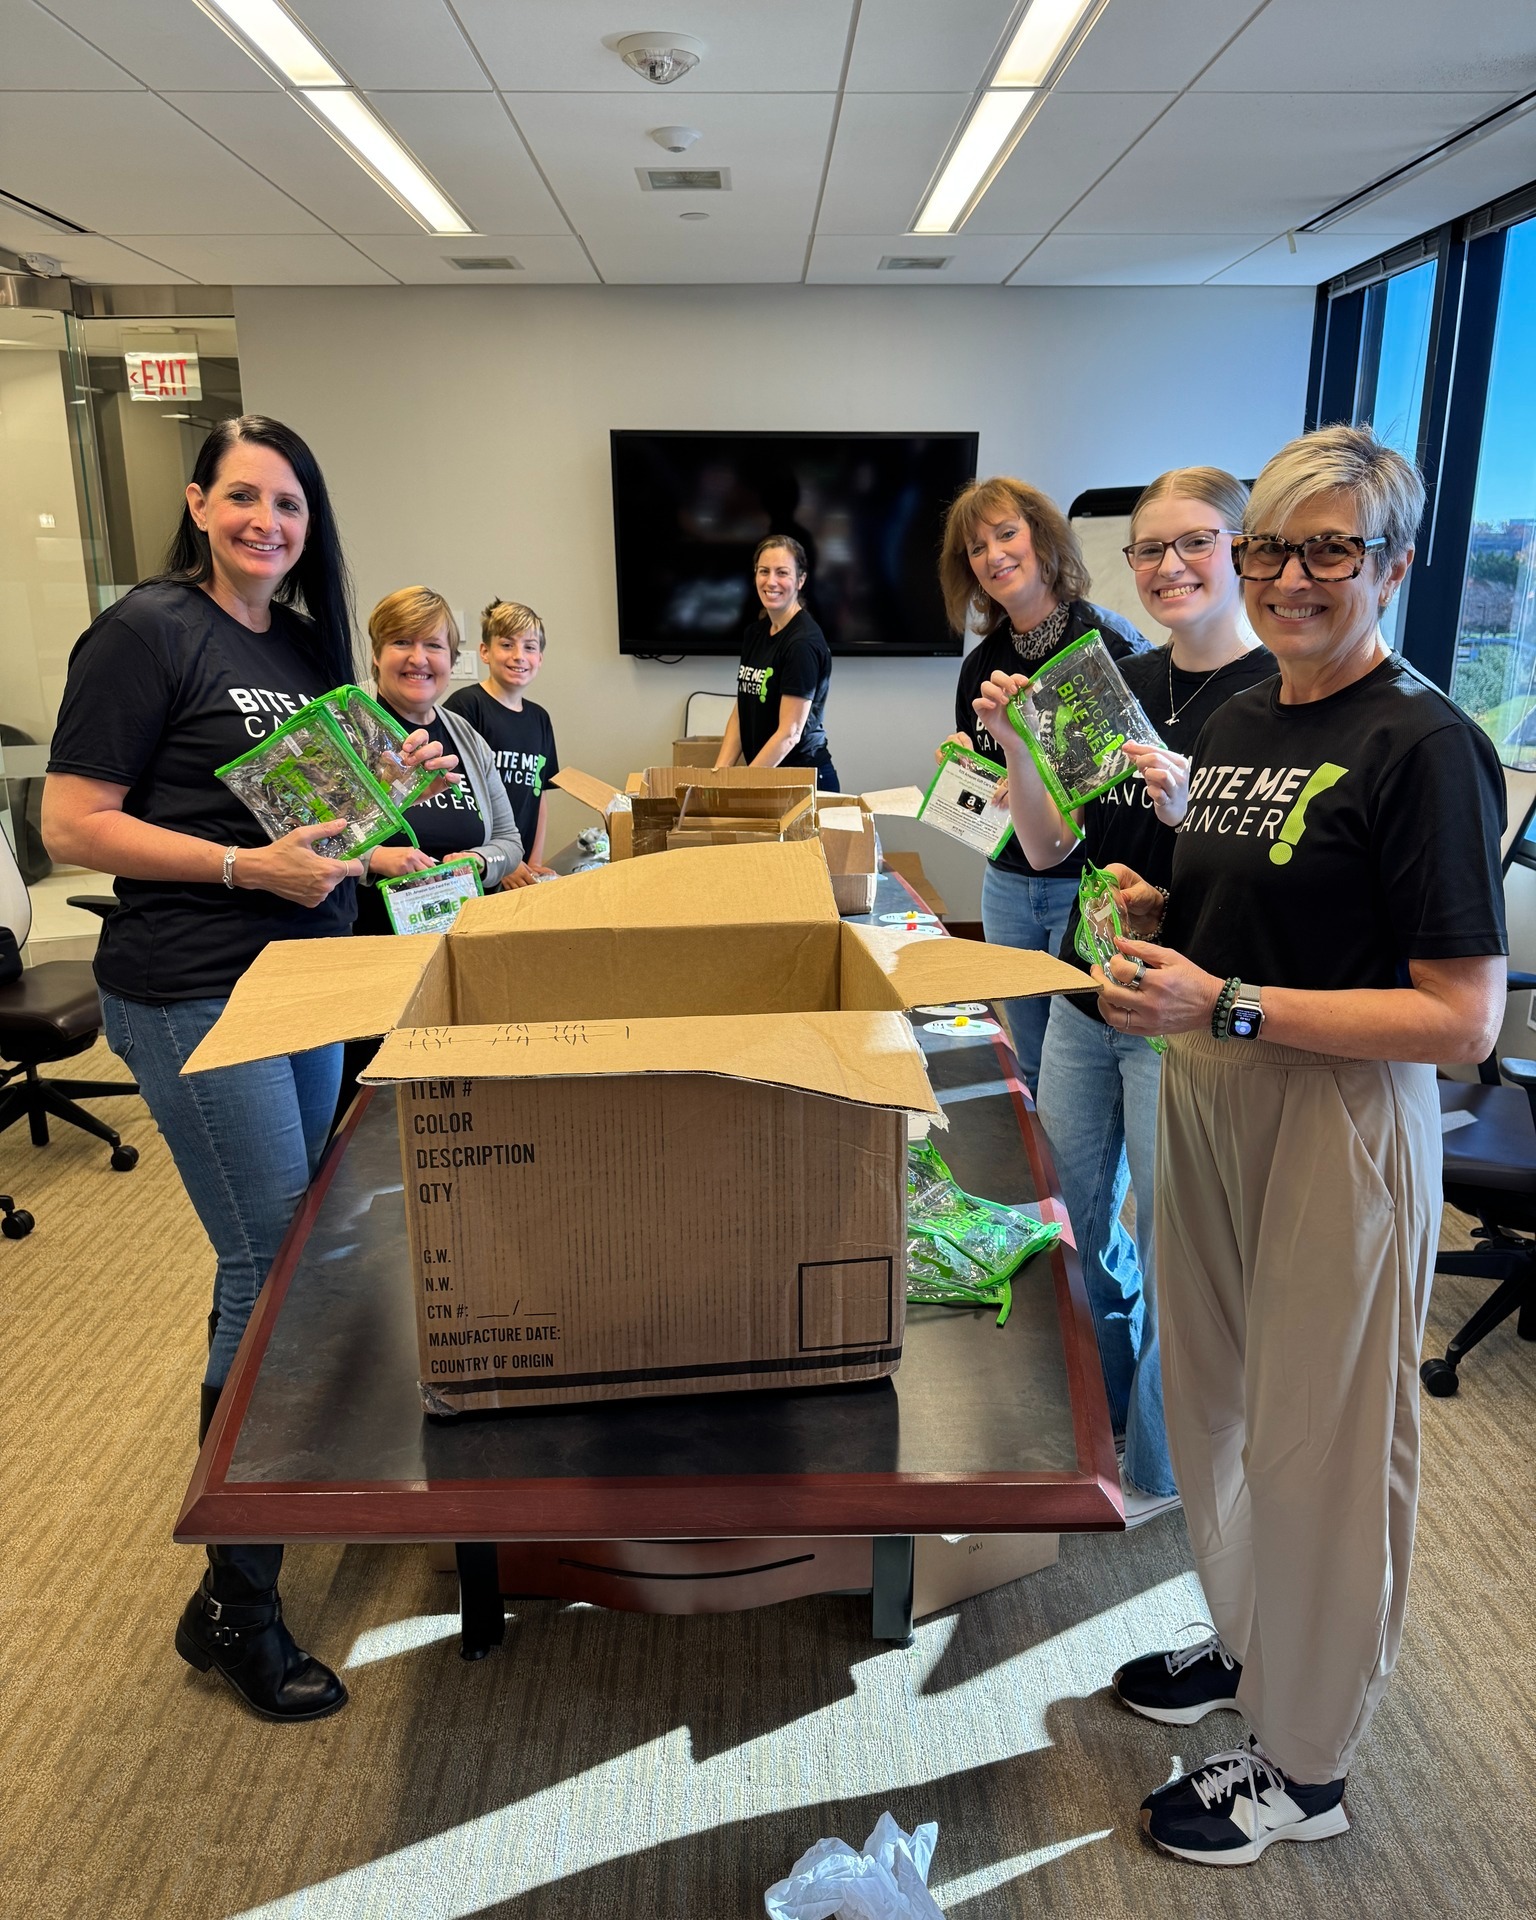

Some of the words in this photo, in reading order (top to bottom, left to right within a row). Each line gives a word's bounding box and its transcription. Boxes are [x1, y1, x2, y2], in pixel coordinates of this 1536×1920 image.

[141, 359, 188, 396] EXIT
[228, 688, 300, 714] BITE
[1187, 766, 1255, 802] BITE
[1244, 767, 1312, 803] ME
[1176, 805, 1285, 841] ANCER
[410, 1080, 455, 1100] ITEM
[414, 1112, 474, 1135] COLOR
[416, 1143, 536, 1169] DESCRIPTION
[419, 1182, 453, 1205] QTY
[423, 1249, 452, 1265] G.W.
[425, 1277, 454, 1292] N.W.
[427, 1304, 452, 1320] CTN
[428, 1327, 522, 1347] MANUFACTURE
[525, 1326, 561, 1341] DATE:
[430, 1356, 489, 1375] COUNTRY
[493, 1354, 509, 1370] OF
[511, 1353, 554, 1369] ORIGIN
